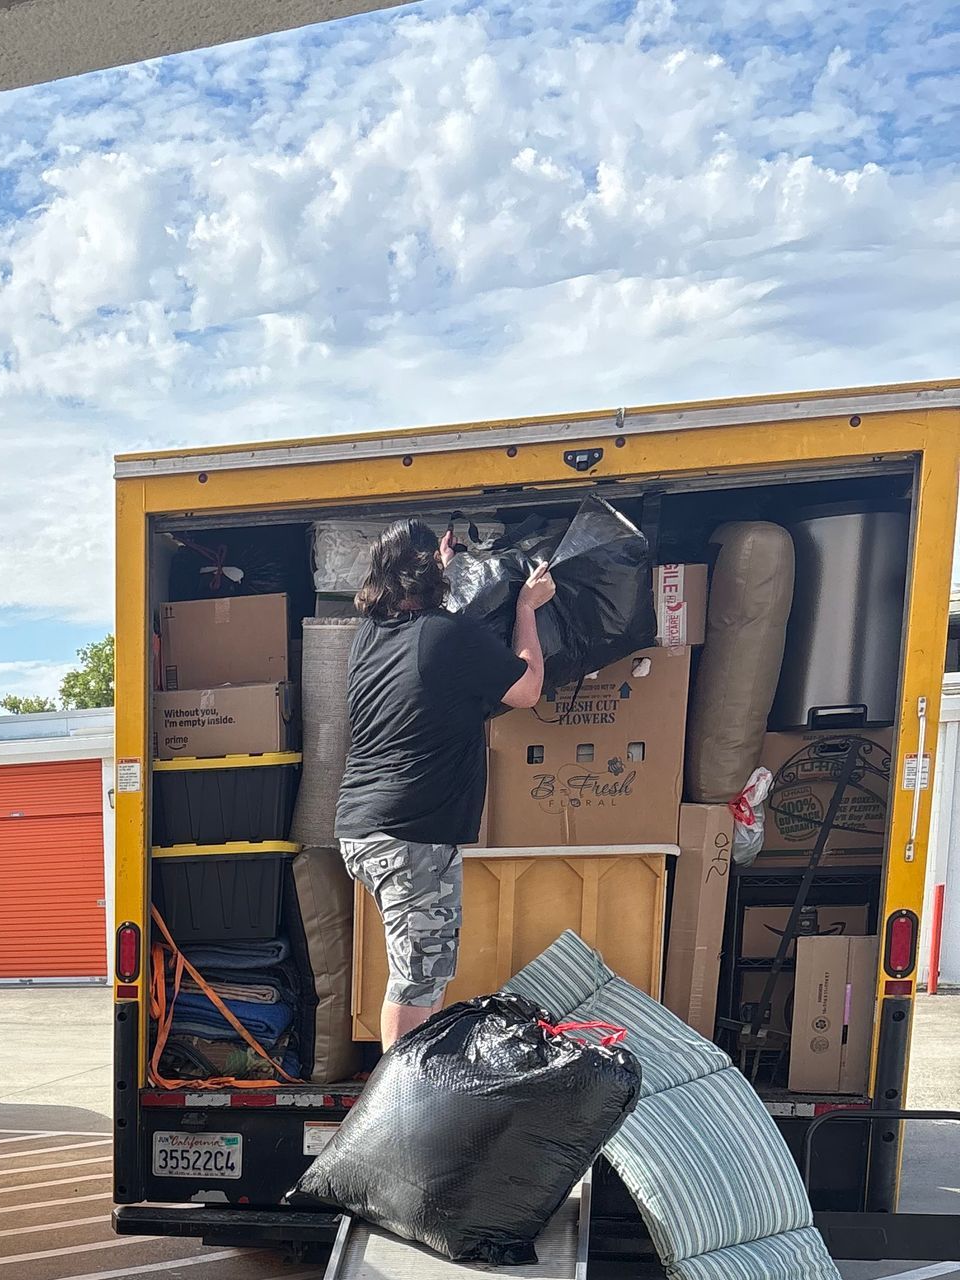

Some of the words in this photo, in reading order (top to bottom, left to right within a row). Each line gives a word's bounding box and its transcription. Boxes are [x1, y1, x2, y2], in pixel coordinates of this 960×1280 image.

[555, 701, 593, 712] FRESH
[596, 700, 619, 711] CUT
[164, 708, 199, 718] Without
[200, 708, 219, 717] you,
[558, 712, 616, 725] FLOWERS
[164, 719, 177, 728] I'm
[178, 718, 206, 728] empty
[207, 715, 236, 725] inside.
[165, 736, 189, 746] prime
[548, 798, 616, 807] FLORAL
[781, 798, 816, 813] 100%
[171, 1135, 223, 1149] California
[159, 1149, 236, 1172] 35522C4
